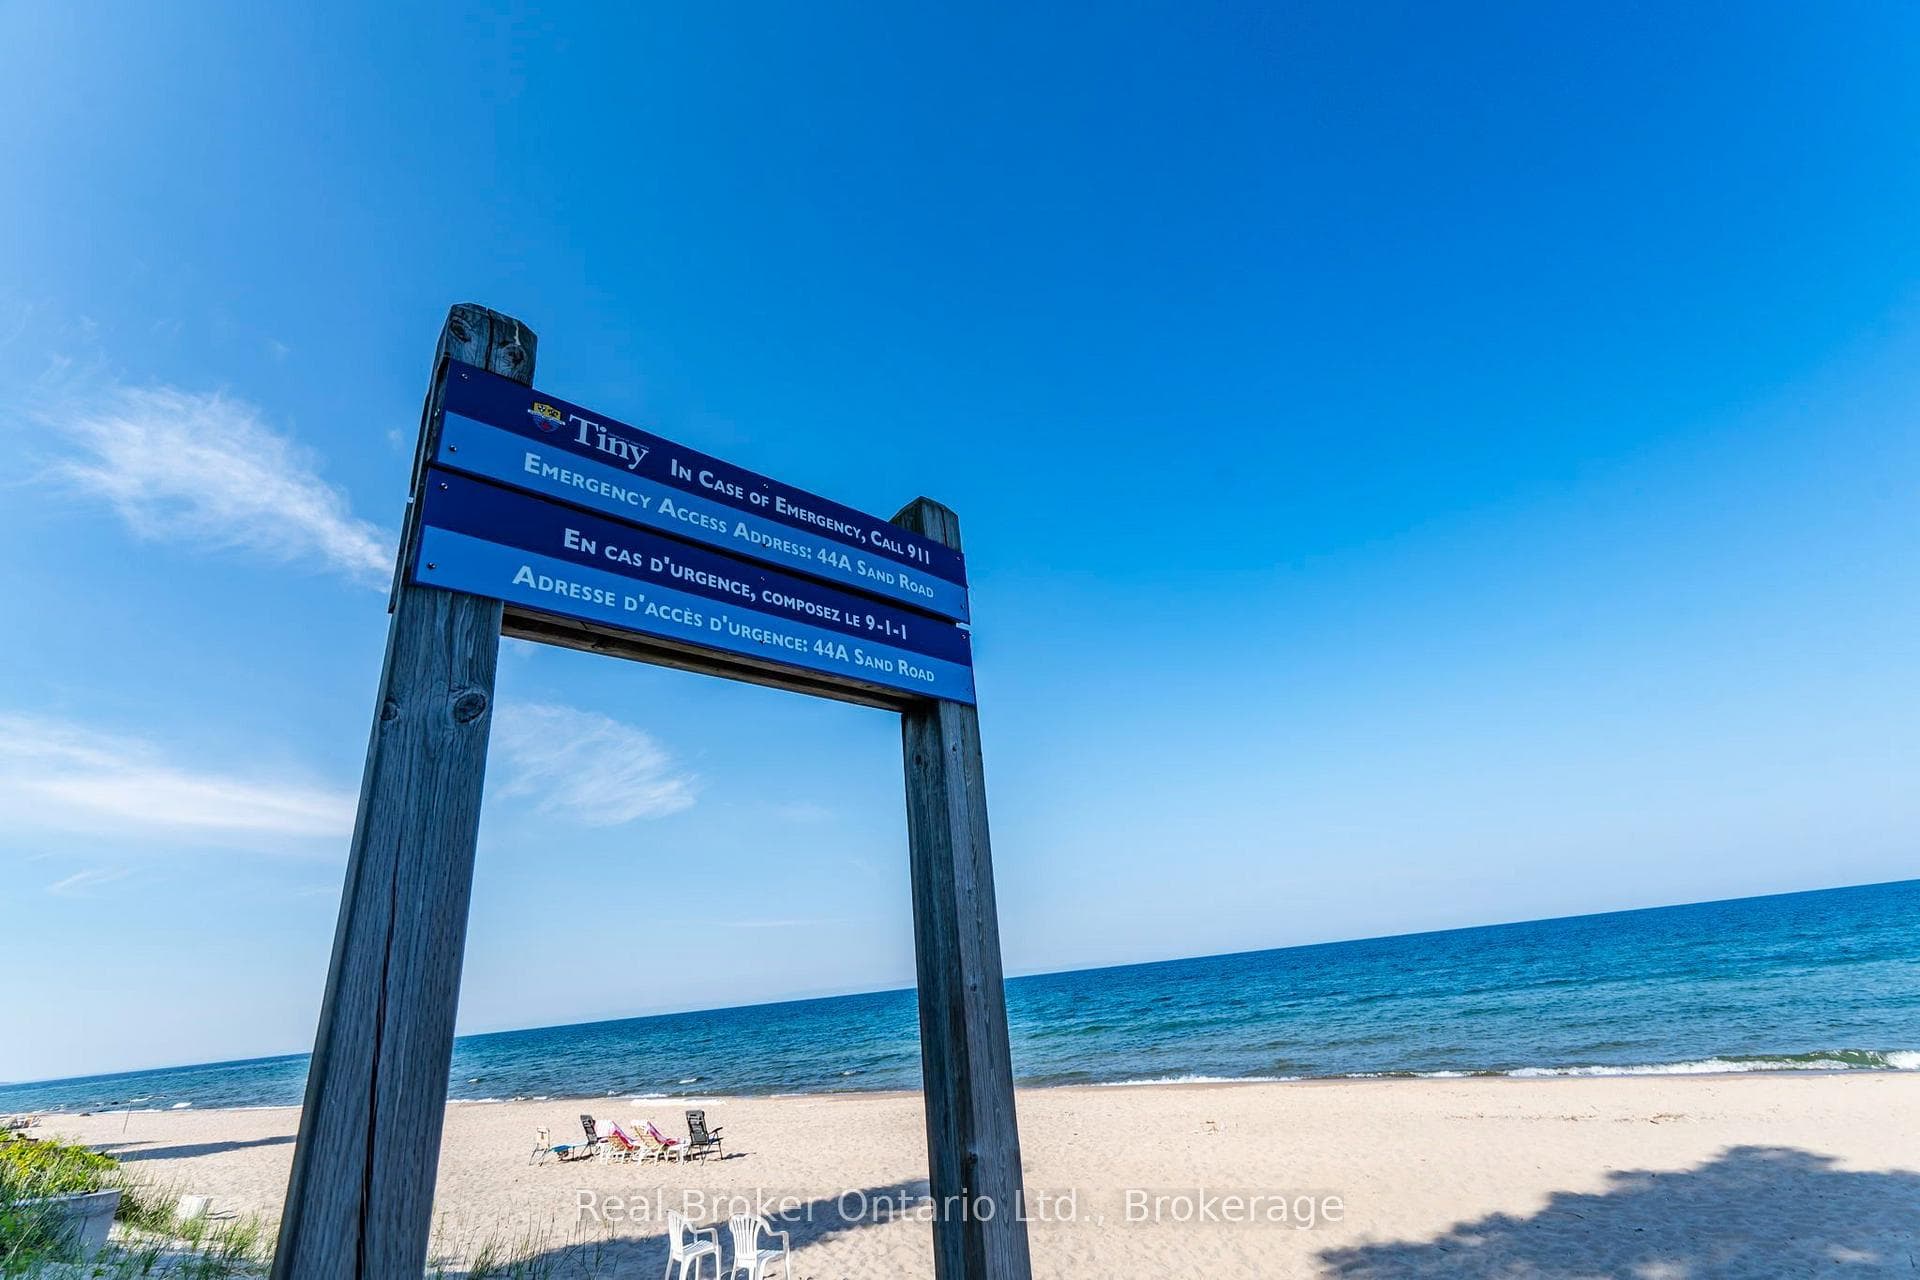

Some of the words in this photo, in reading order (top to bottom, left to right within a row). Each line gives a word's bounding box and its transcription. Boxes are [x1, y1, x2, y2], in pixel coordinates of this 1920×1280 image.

[569, 414, 649, 470] Tiny
[524, 452, 651, 508] EMERGENCY
[658, 498, 727, 533] ACCESS
[733, 522, 811, 559] ADDRESS:
[817, 548, 851, 572] 44A
[857, 560, 894, 585] SAND
[900, 573, 934, 598] ROAD
[671, 459, 691, 481] IN
[699, 470, 743, 499] CASE
[750, 492, 769, 507] OF
[776, 496, 866, 543] EMERGENCY,
[871, 530, 904, 555] CALL
[907, 544, 930, 564] 911
[512, 565, 615, 606] ADRESSE
[624, 594, 702, 627] D'ACCÈS
[710, 615, 808, 652] D'URGENCE:
[813, 639, 849, 662] 44A
[854, 649, 893, 672] SAND
[898, 659, 935, 682] ROAD
[564, 528, 596, 554] EN
[605, 546, 642, 566] CAS
[650, 557, 755, 602] D'URGENCE,
[762, 590, 840, 622] COMPOSEZ
[846, 612, 860, 627] LE
[866, 614, 907, 640] 9-1-1
